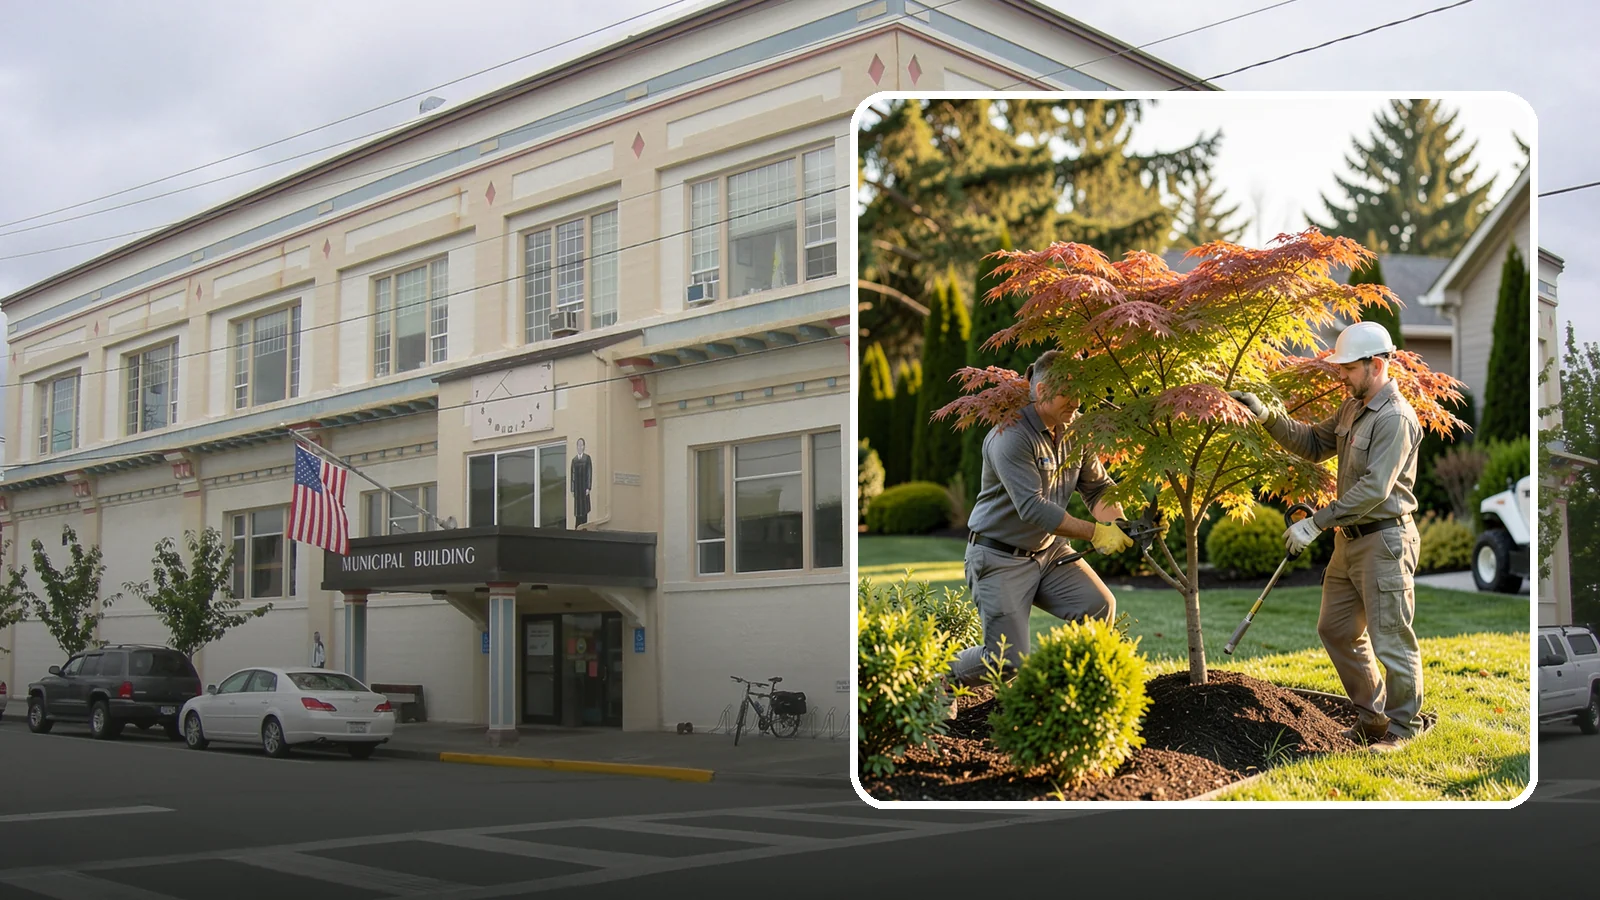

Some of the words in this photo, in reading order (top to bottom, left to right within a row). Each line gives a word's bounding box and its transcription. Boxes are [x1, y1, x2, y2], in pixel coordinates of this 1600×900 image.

[521, 420, 525, 428] 2
[529, 414, 533, 422] 3
[547, 362, 551, 370] 6
[342, 552, 405, 572] MUNICIPAL
[414, 547, 475, 566] BUILDING
